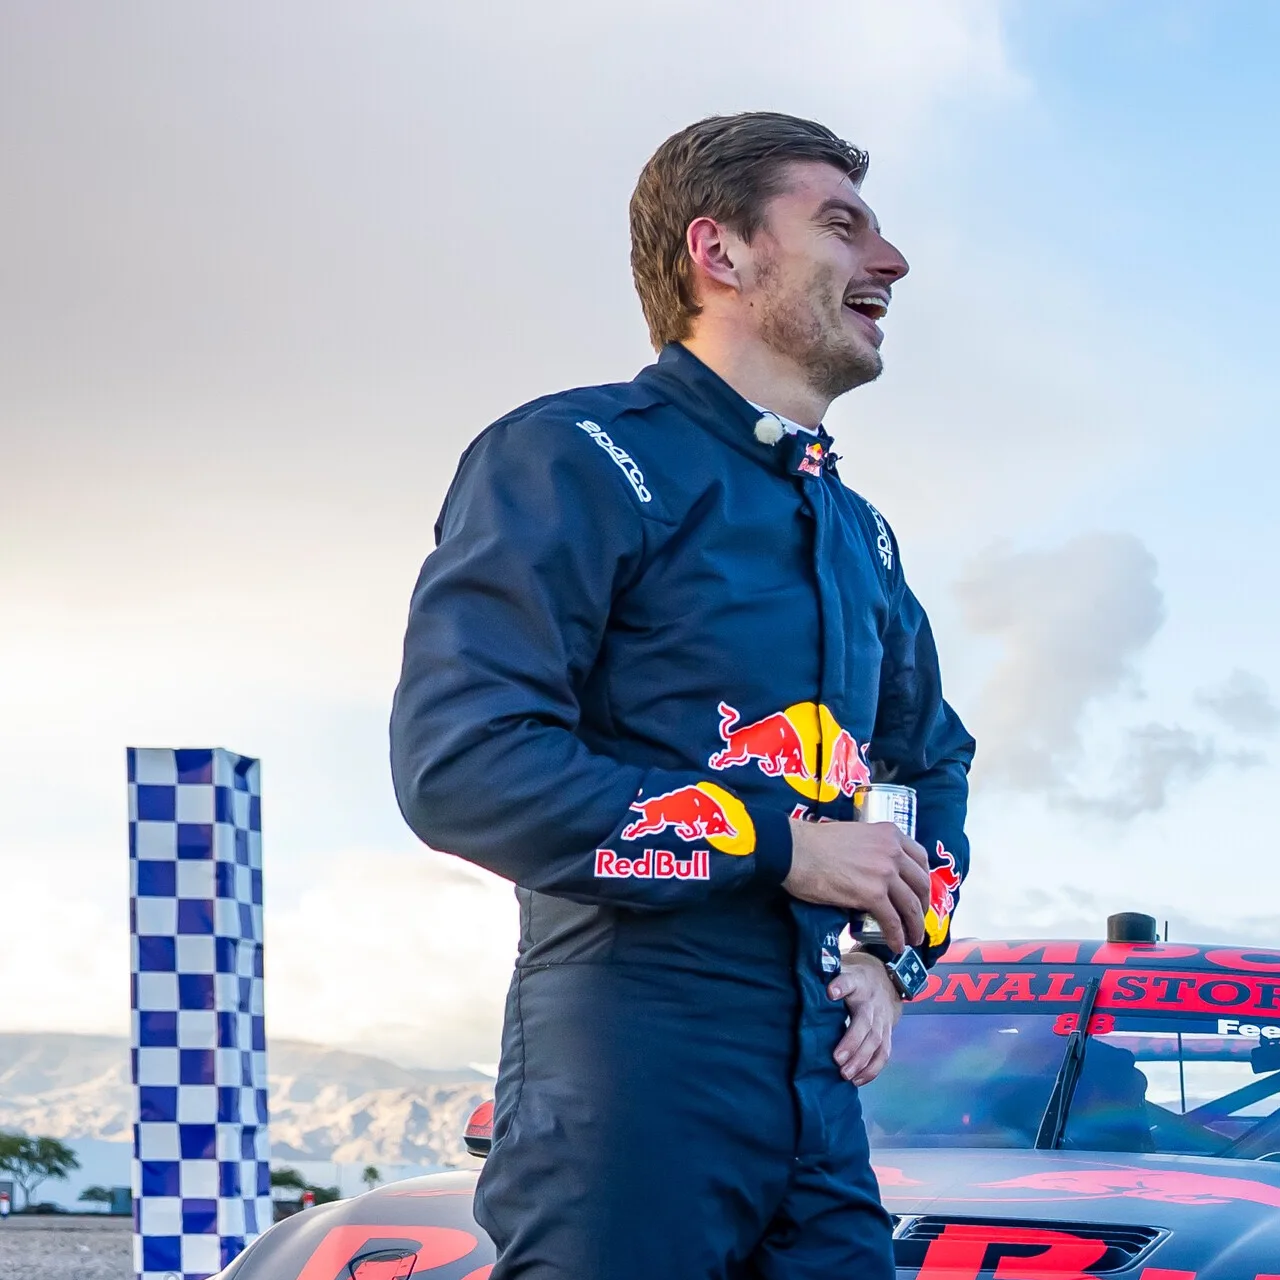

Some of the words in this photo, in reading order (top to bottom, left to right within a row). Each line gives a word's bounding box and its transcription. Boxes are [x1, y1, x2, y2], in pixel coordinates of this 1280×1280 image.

[576, 420, 652, 503] sparco
[594, 849, 653, 878] Red
[654, 850, 710, 880] Bull
[1052, 1013, 1116, 1036] 88
